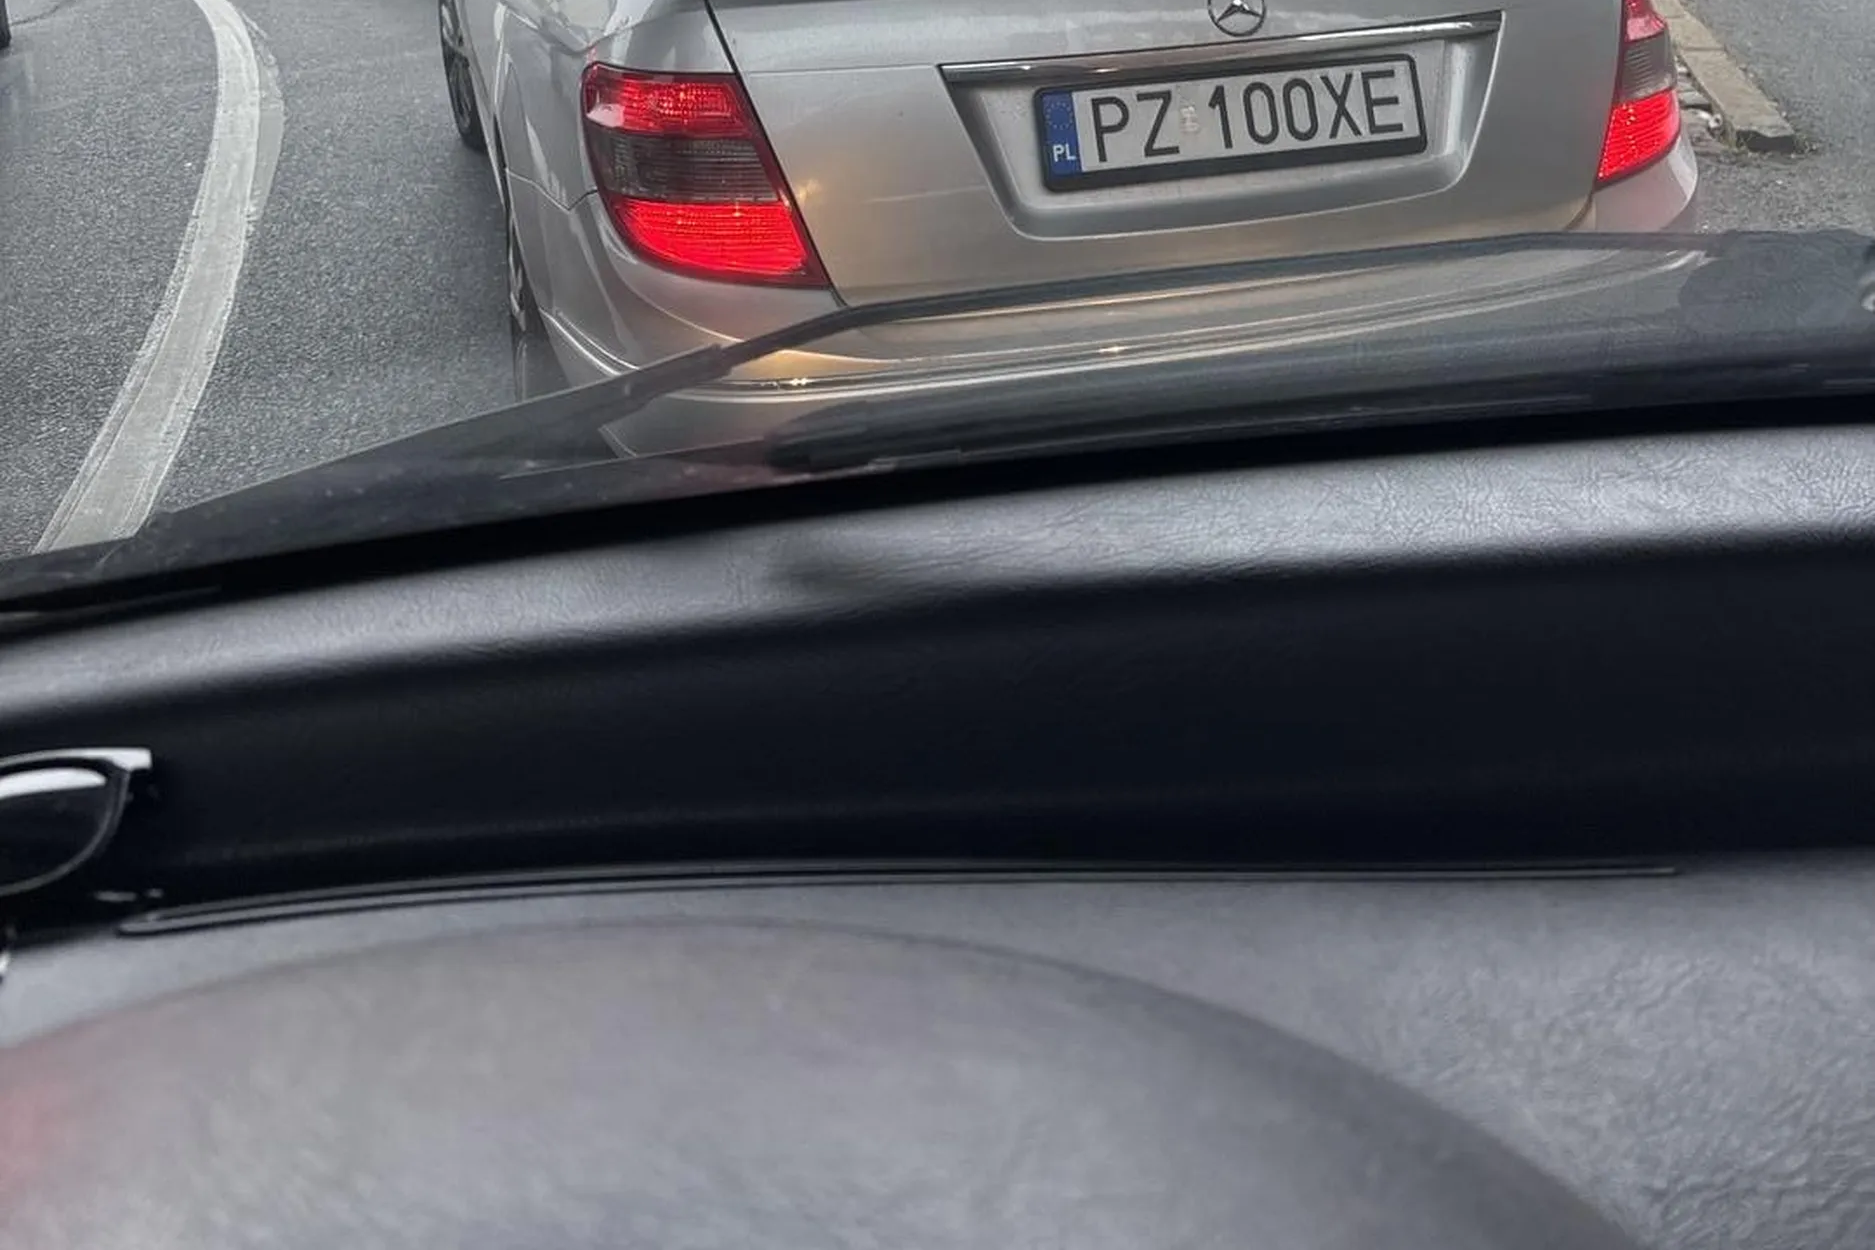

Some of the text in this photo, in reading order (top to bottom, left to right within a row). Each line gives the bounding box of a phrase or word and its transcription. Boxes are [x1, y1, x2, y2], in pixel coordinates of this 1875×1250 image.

[1089, 68, 1404, 163] PZ 100XE
[1052, 144, 1077, 163] PL
